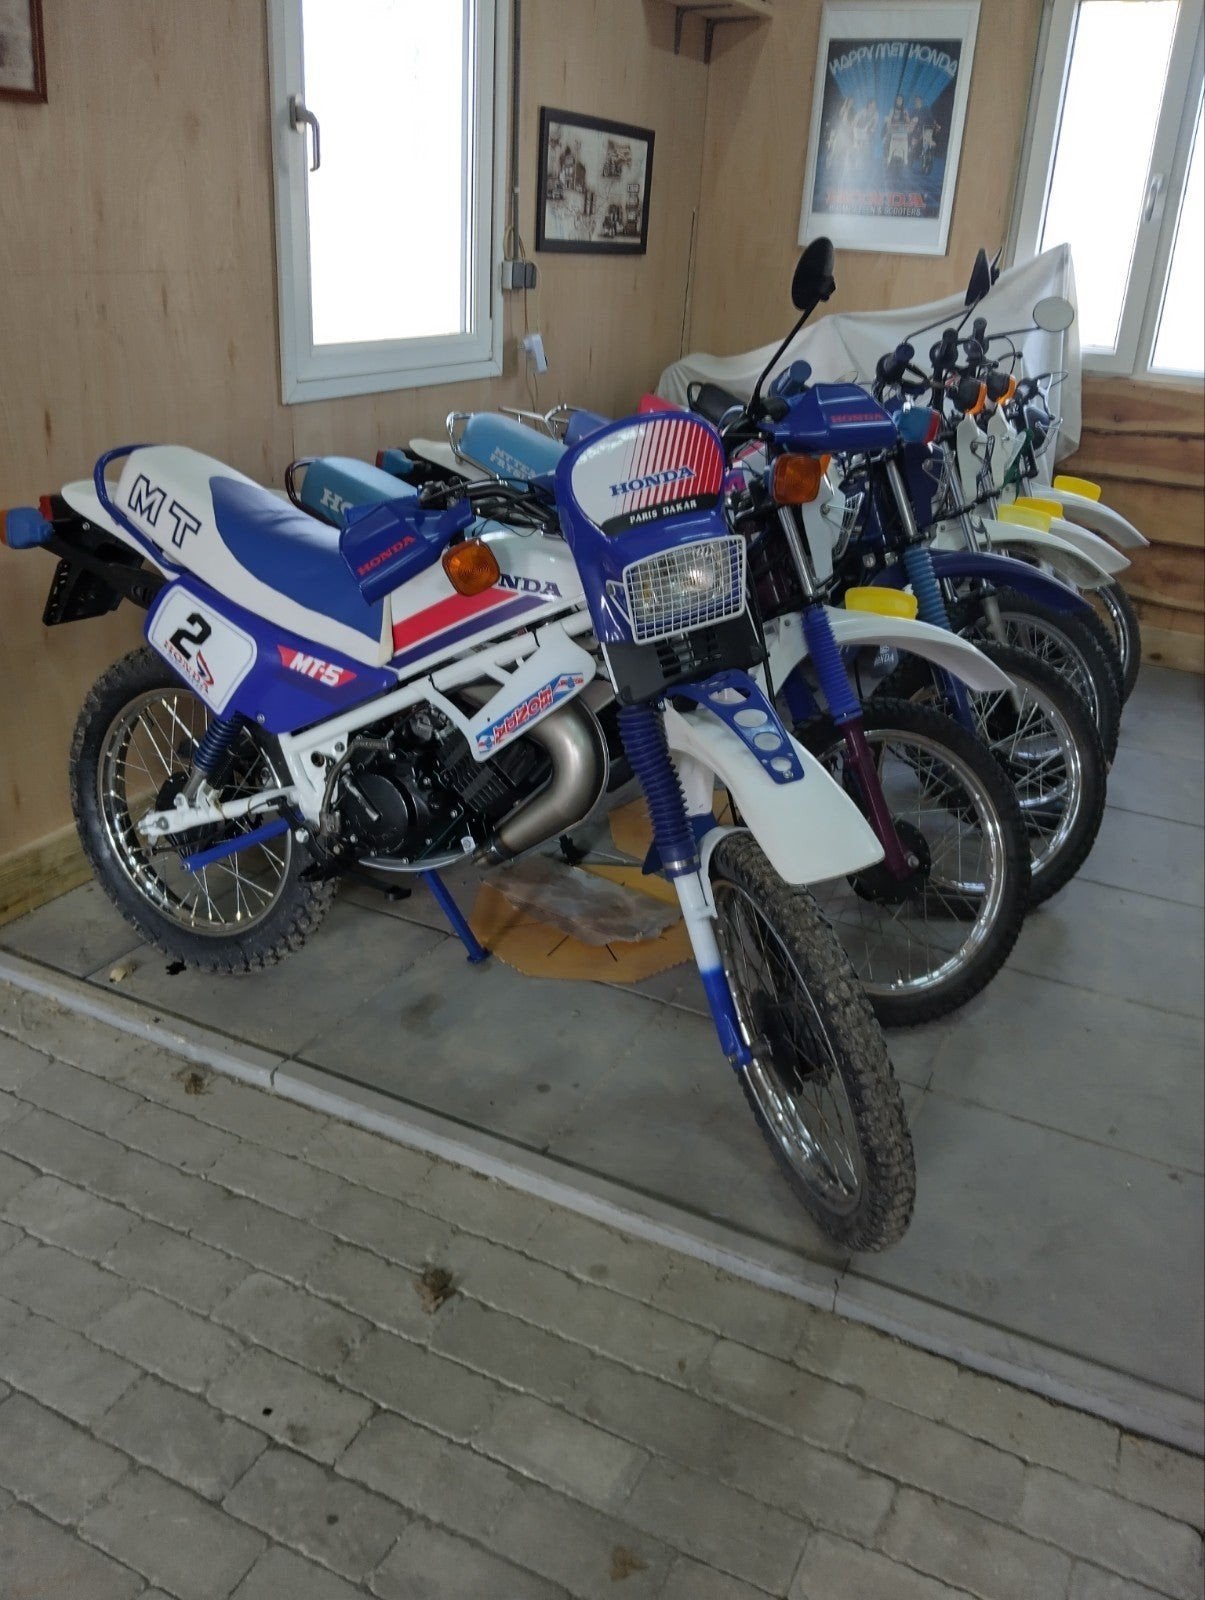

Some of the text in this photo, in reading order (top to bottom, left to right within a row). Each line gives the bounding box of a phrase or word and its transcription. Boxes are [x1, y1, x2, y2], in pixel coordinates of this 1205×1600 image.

[829, 43, 875, 75] HAPPY
[908, 43, 959, 77] HONDA
[831, 412, 885, 423] HONDA
[609, 465, 696, 497] HONDA
[128, 473, 202, 549] MT
[629, 499, 697, 525] PARIS DAKAR
[357, 535, 416, 576] HONDA
[498, 573, 562, 598] NDA
[170, 612, 212, 660] 2
